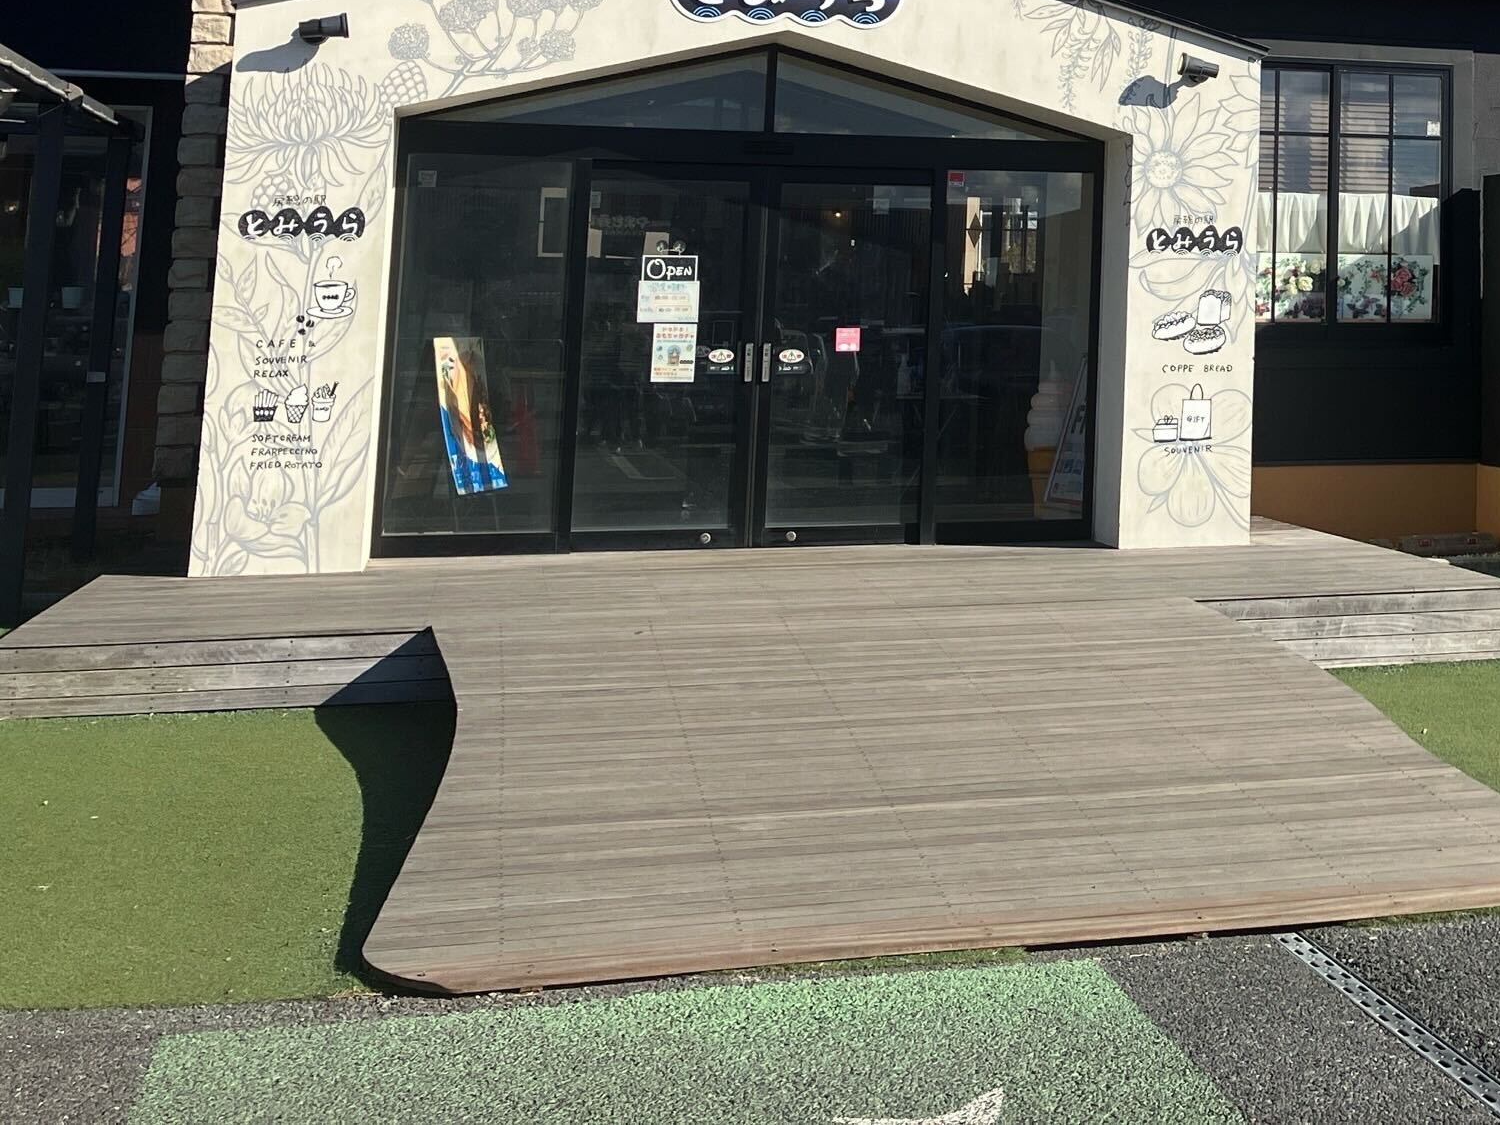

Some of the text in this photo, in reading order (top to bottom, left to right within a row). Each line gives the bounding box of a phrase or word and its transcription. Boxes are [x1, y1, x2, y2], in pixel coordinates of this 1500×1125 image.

[245, 213, 359, 235] とみうら
[1151, 230, 1239, 251] とみうら
[255, 338, 297, 349] CAFE
[253, 369, 290, 379] RELAX
[1161, 363, 1234, 374] COPPE BREAD
[1163, 443, 1213, 456] SOUVENIR
[249, 460, 282, 471] FRIED
